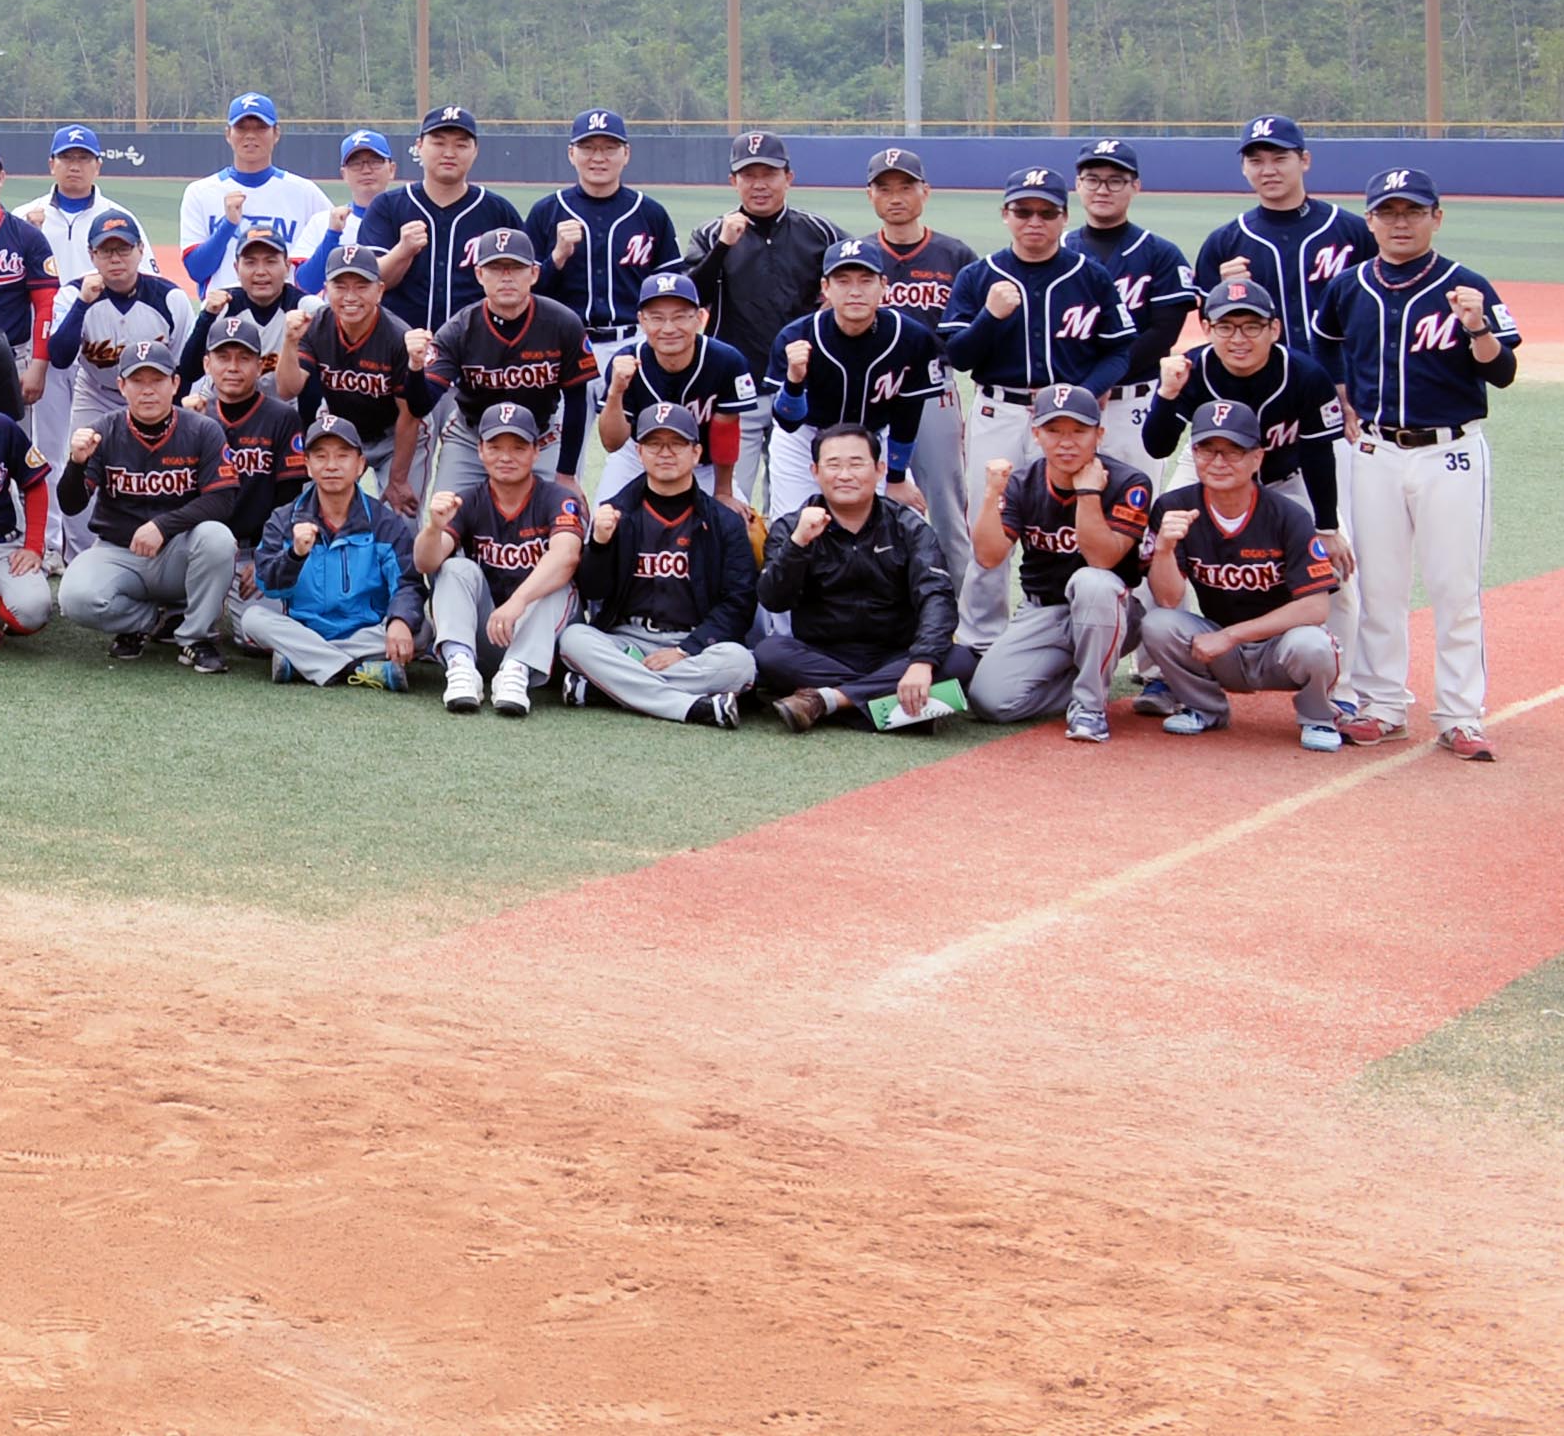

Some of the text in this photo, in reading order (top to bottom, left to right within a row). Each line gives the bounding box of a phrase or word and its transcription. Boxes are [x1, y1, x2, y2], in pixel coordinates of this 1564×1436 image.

[442, 106, 461, 121] M
[588, 113, 608, 130] M
[1252, 118, 1274, 137] M
[748, 135, 763, 154] F
[1094, 140, 1119, 153] M
[886, 148, 900, 166] F
[1023, 170, 1048, 185] M
[1384, 171, 1409, 189] M
[495, 231, 512, 253] F
[619, 235, 654, 266] M
[840, 240, 861, 257] M
[344, 246, 357, 264] F
[1309, 245, 1354, 282] M
[656, 277, 675, 292] M
[878, 283, 951, 310] LCONS
[227, 316, 242, 335] F
[1056, 306, 1101, 339] M
[1410, 312, 1459, 352] M
[136, 342, 151, 360] F
[462, 363, 562, 390] FALCONS
[871, 367, 910, 402] M
[1053, 387, 1070, 407] F
[321, 415, 337, 431] F
[499, 405, 515, 424] F
[658, 404, 670, 423] F
[1213, 403, 1231, 425] F
[1445, 452, 1471, 471] 35
[1024, 526, 1078, 553] FALC
[473, 536, 551, 571] FALCON
